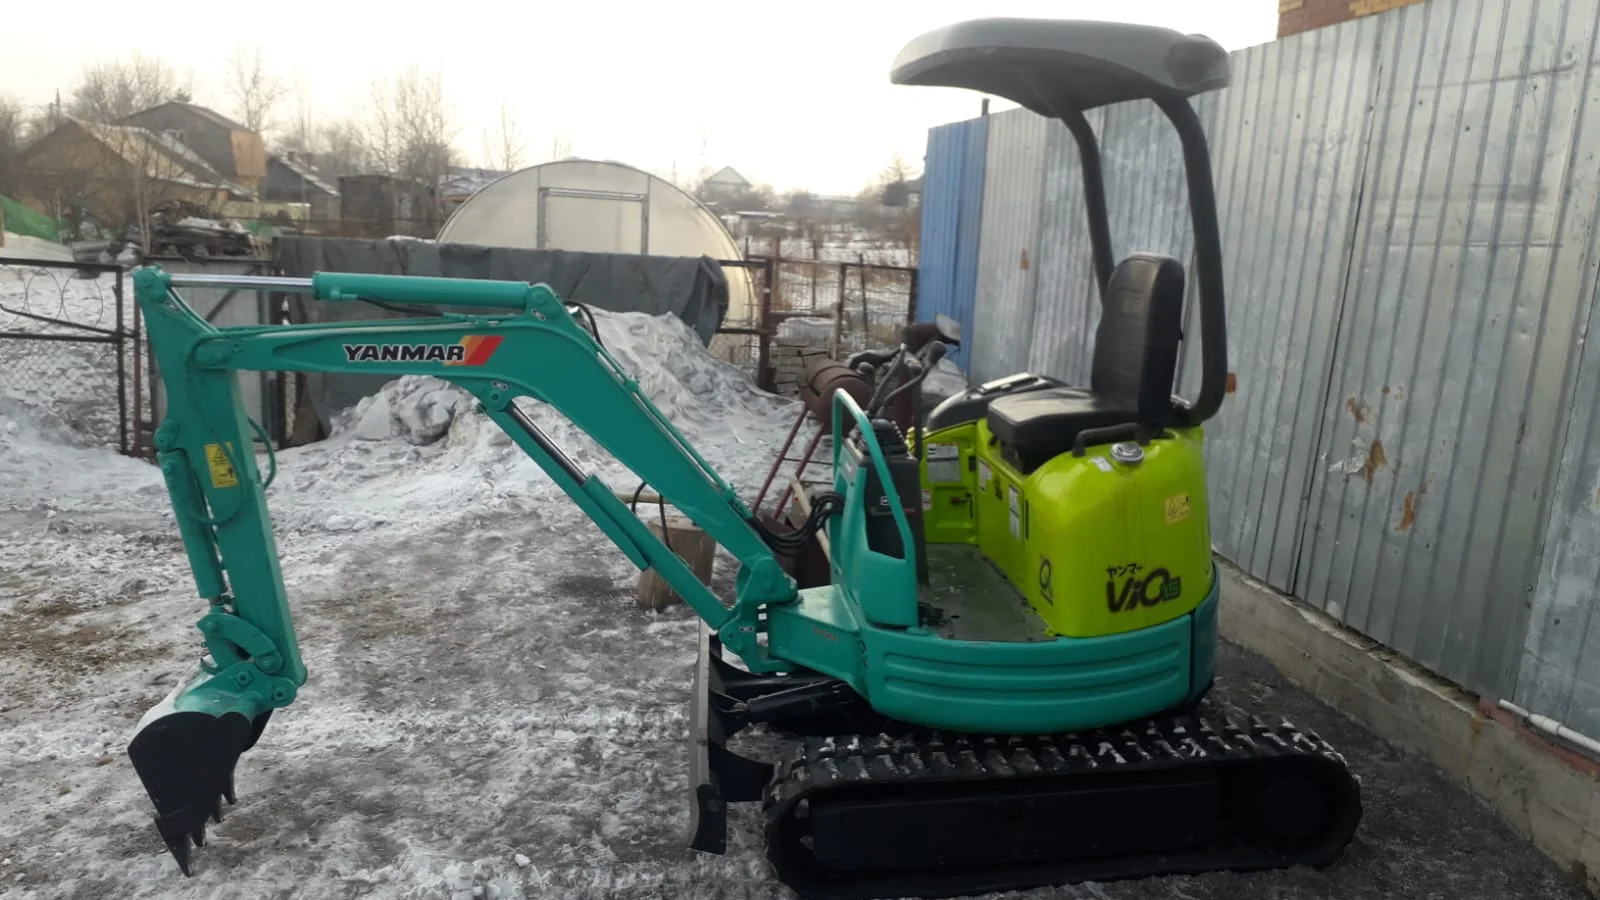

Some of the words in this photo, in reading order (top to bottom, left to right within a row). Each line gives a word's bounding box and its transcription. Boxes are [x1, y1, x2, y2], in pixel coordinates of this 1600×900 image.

[343, 344, 465, 361] YANMAR
[1106, 563, 1142, 578] ヤンマー
